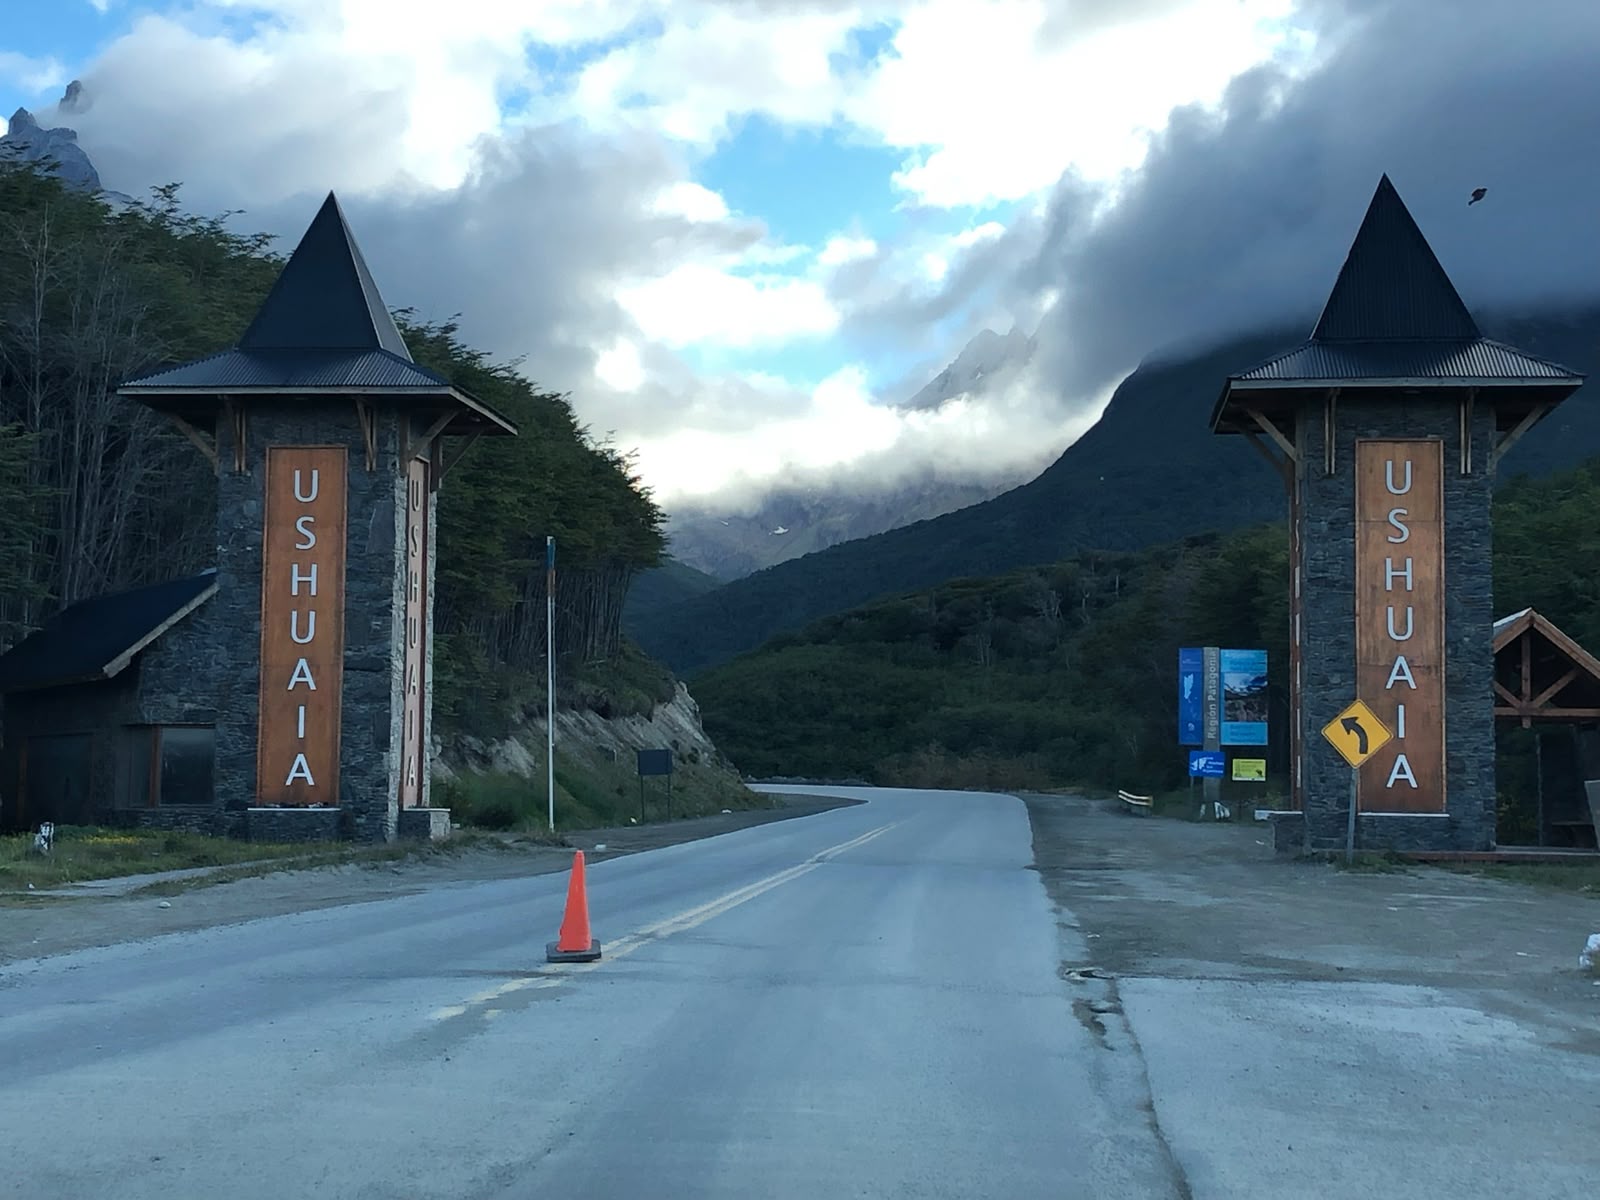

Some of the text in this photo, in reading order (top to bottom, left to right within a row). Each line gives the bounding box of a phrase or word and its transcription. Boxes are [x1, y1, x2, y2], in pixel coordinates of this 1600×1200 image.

[285, 469, 319, 787] USHUAIA
[406, 479, 421, 787] USHUAIA
[1207, 650, 1218, 739] Región Patagonia
[1385, 460, 1418, 789] USHUAIA
